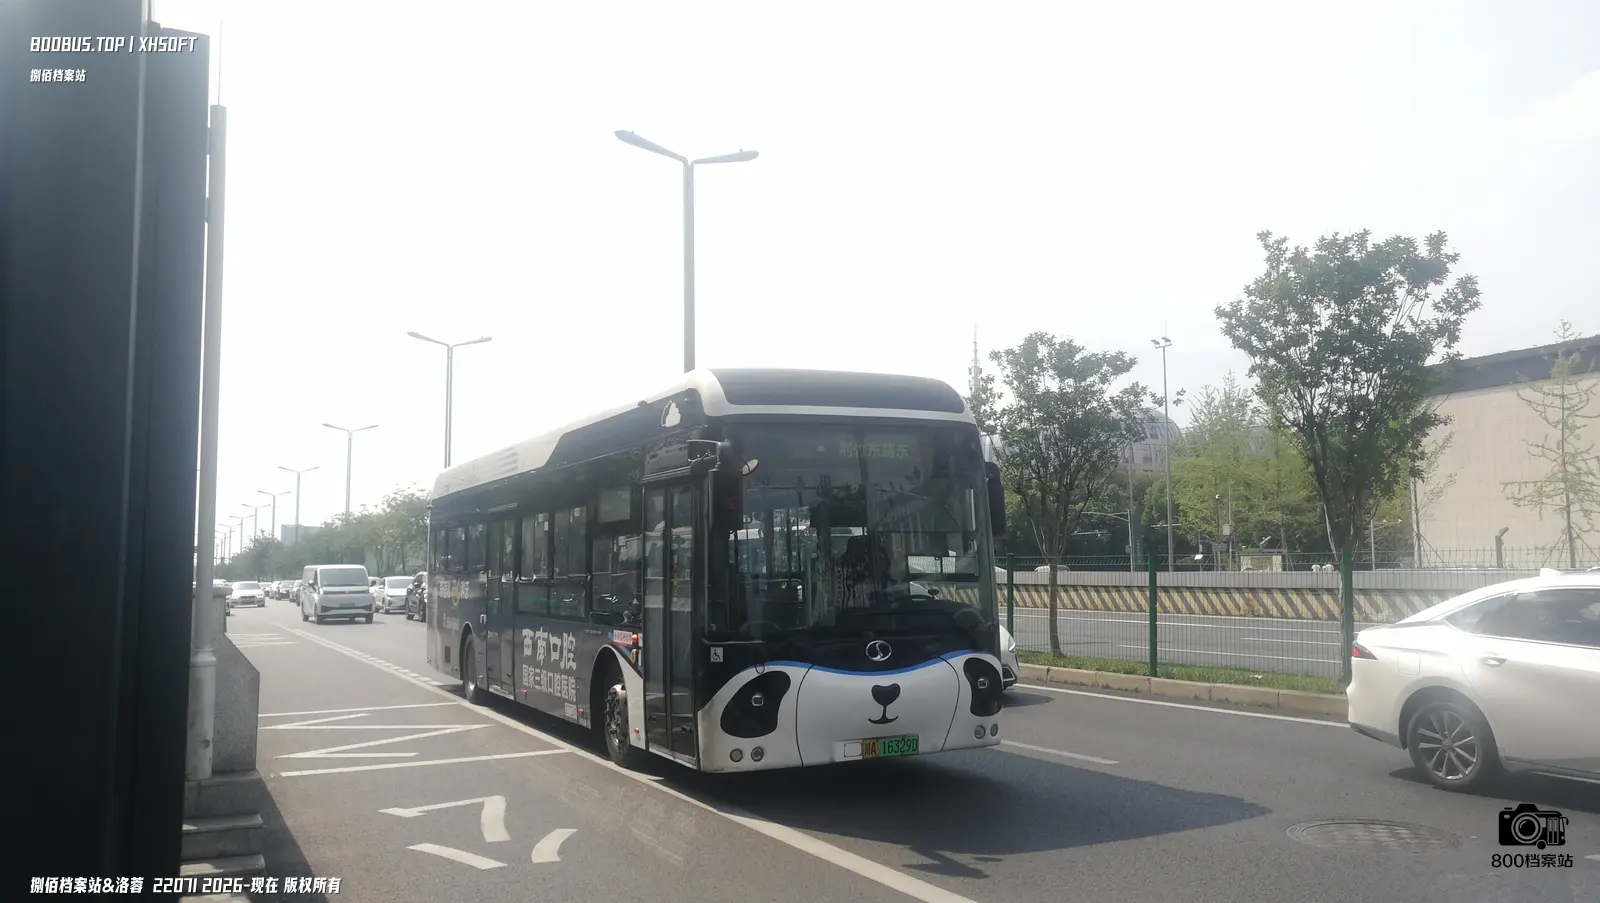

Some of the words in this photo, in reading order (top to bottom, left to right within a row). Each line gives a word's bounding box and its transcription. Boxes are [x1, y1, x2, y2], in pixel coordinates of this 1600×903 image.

[522, 626, 577, 670] 西南口腔
[522, 664, 577, 702] 国家三级口腔医院
[882, 737, 919, 755] 16329D
